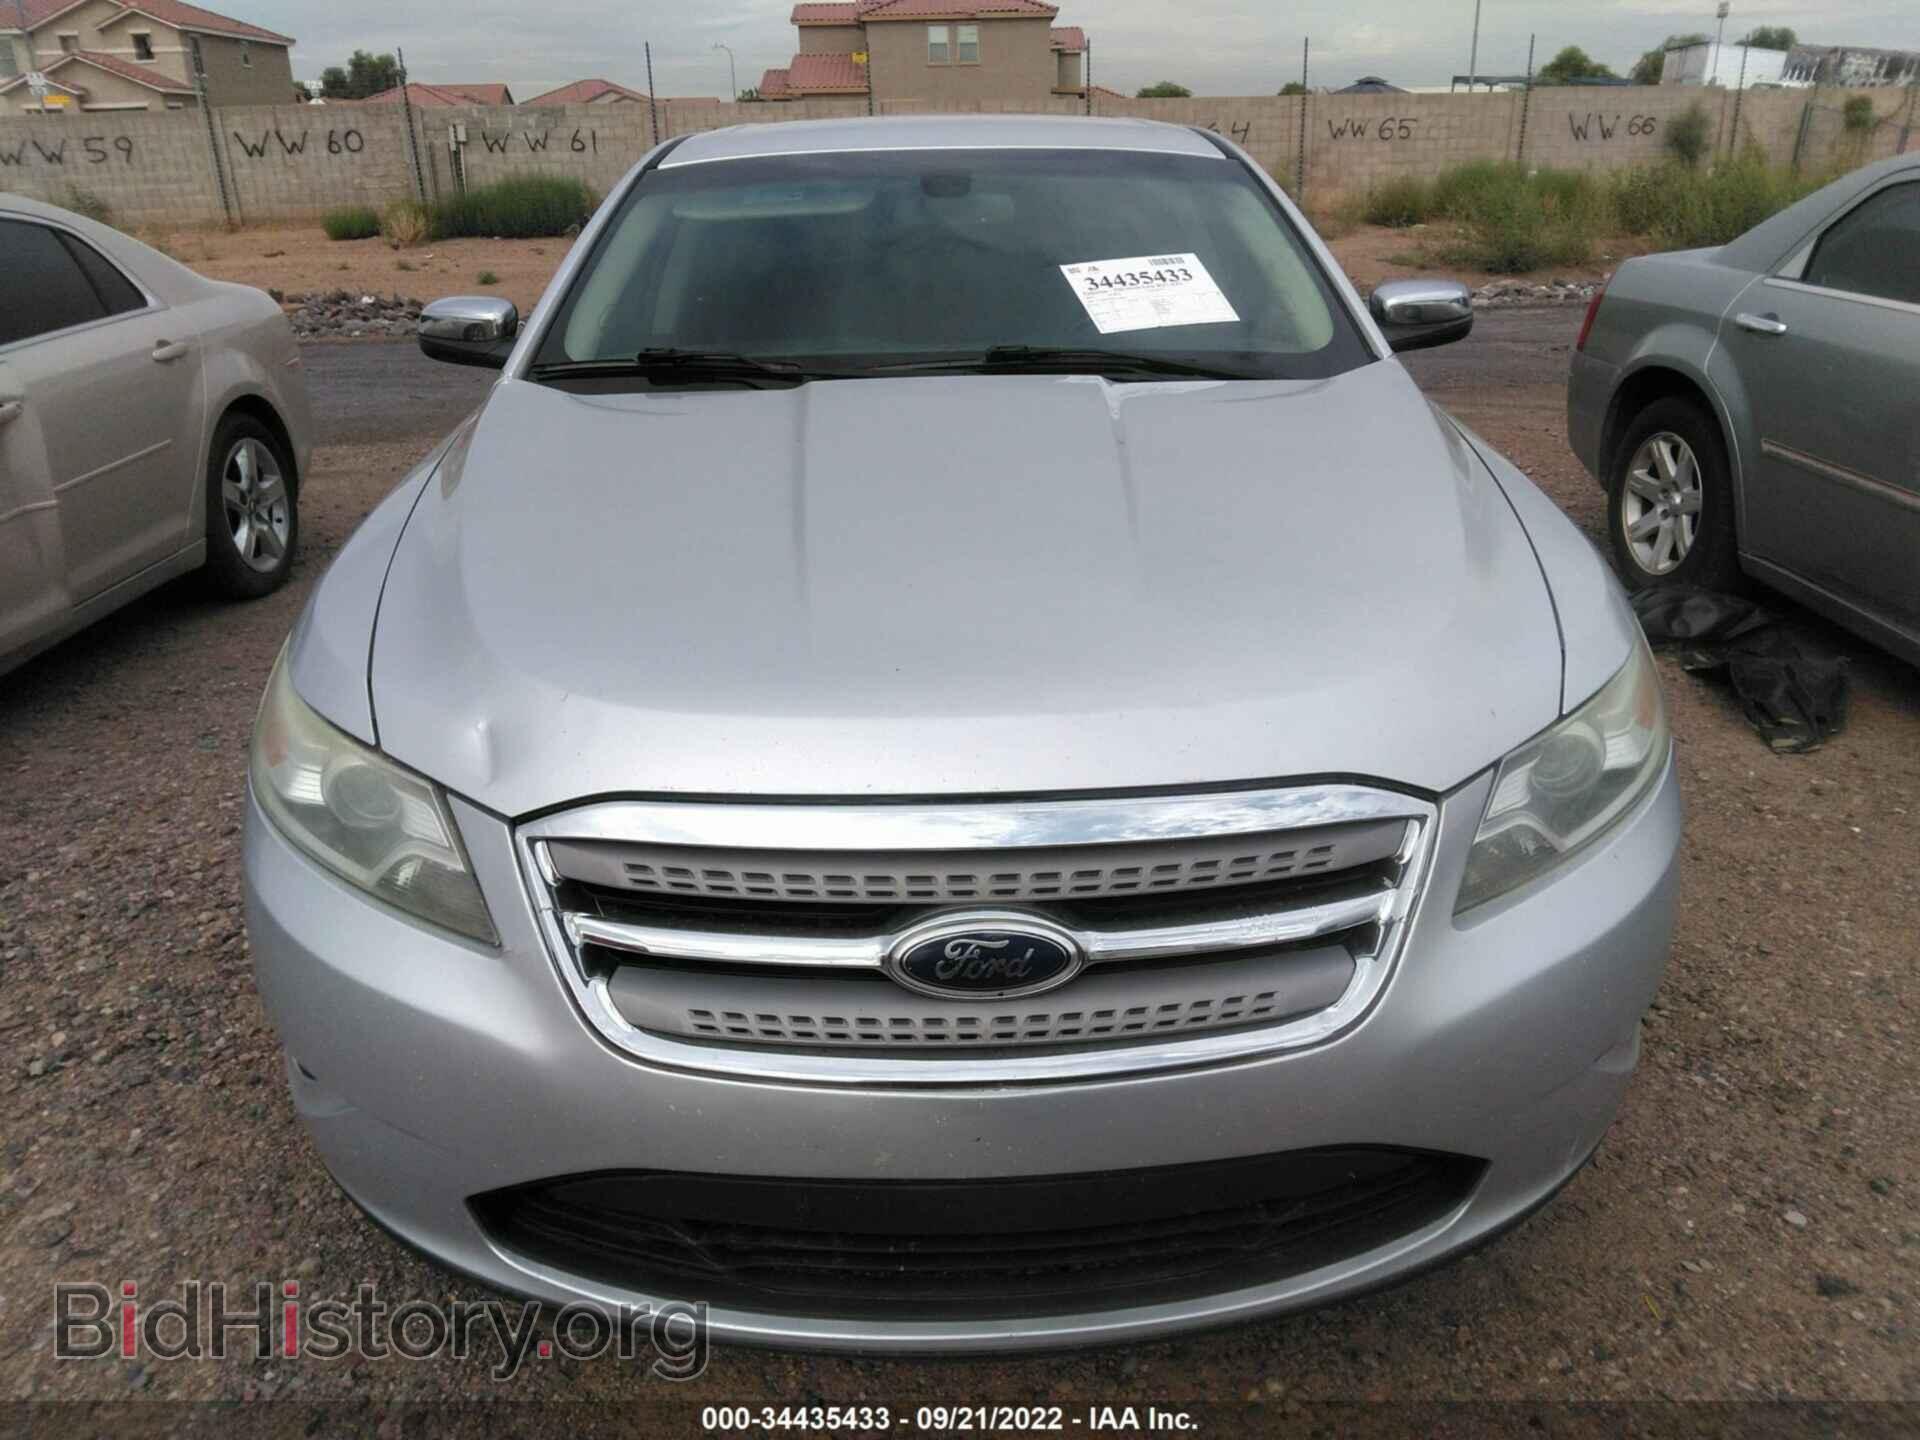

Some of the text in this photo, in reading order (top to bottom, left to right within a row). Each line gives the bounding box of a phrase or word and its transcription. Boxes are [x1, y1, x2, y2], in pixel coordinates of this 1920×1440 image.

[1378, 117, 1418, 141] 65
[1628, 114, 1657, 136] 66
[83, 136, 133, 164] 59
[327, 129, 365, 154] 60
[570, 128, 598, 154] 61
[1084, 267, 1193, 292] 34435433
[935, 938, 1035, 980] Ford
